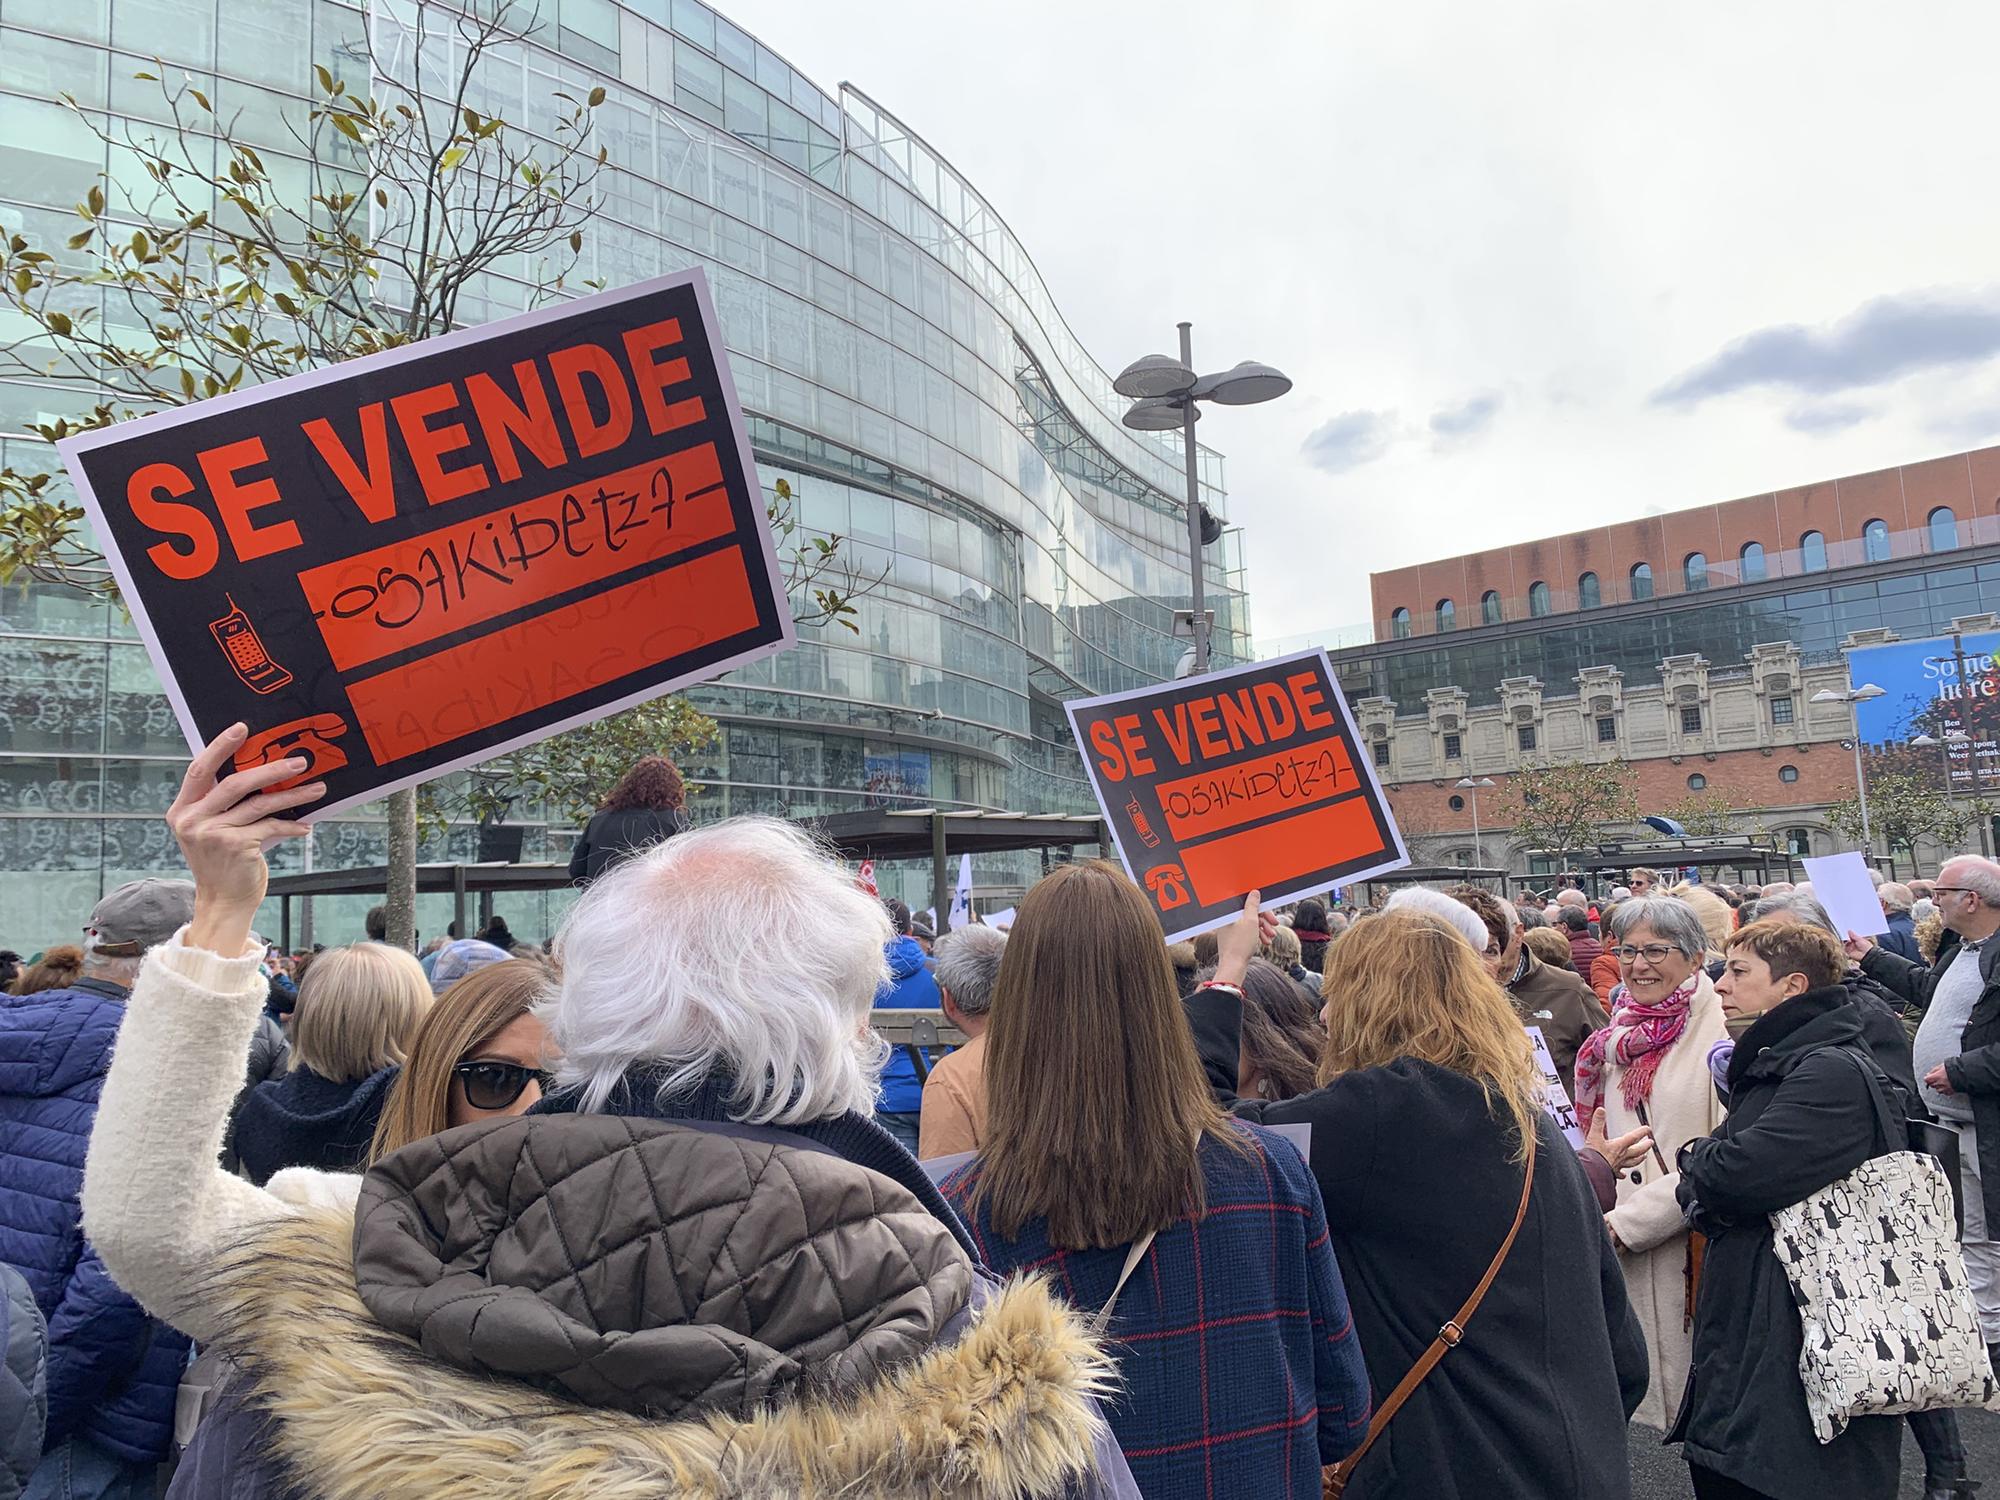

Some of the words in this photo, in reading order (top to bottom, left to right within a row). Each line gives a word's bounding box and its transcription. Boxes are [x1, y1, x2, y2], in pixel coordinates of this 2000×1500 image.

[126, 436, 303, 581] SE
[301, 317, 707, 524] VENDE
[1090, 713, 1157, 783] SE
[1152, 671, 1335, 766] VENDE
[1944, 719, 1961, 727] Ben
